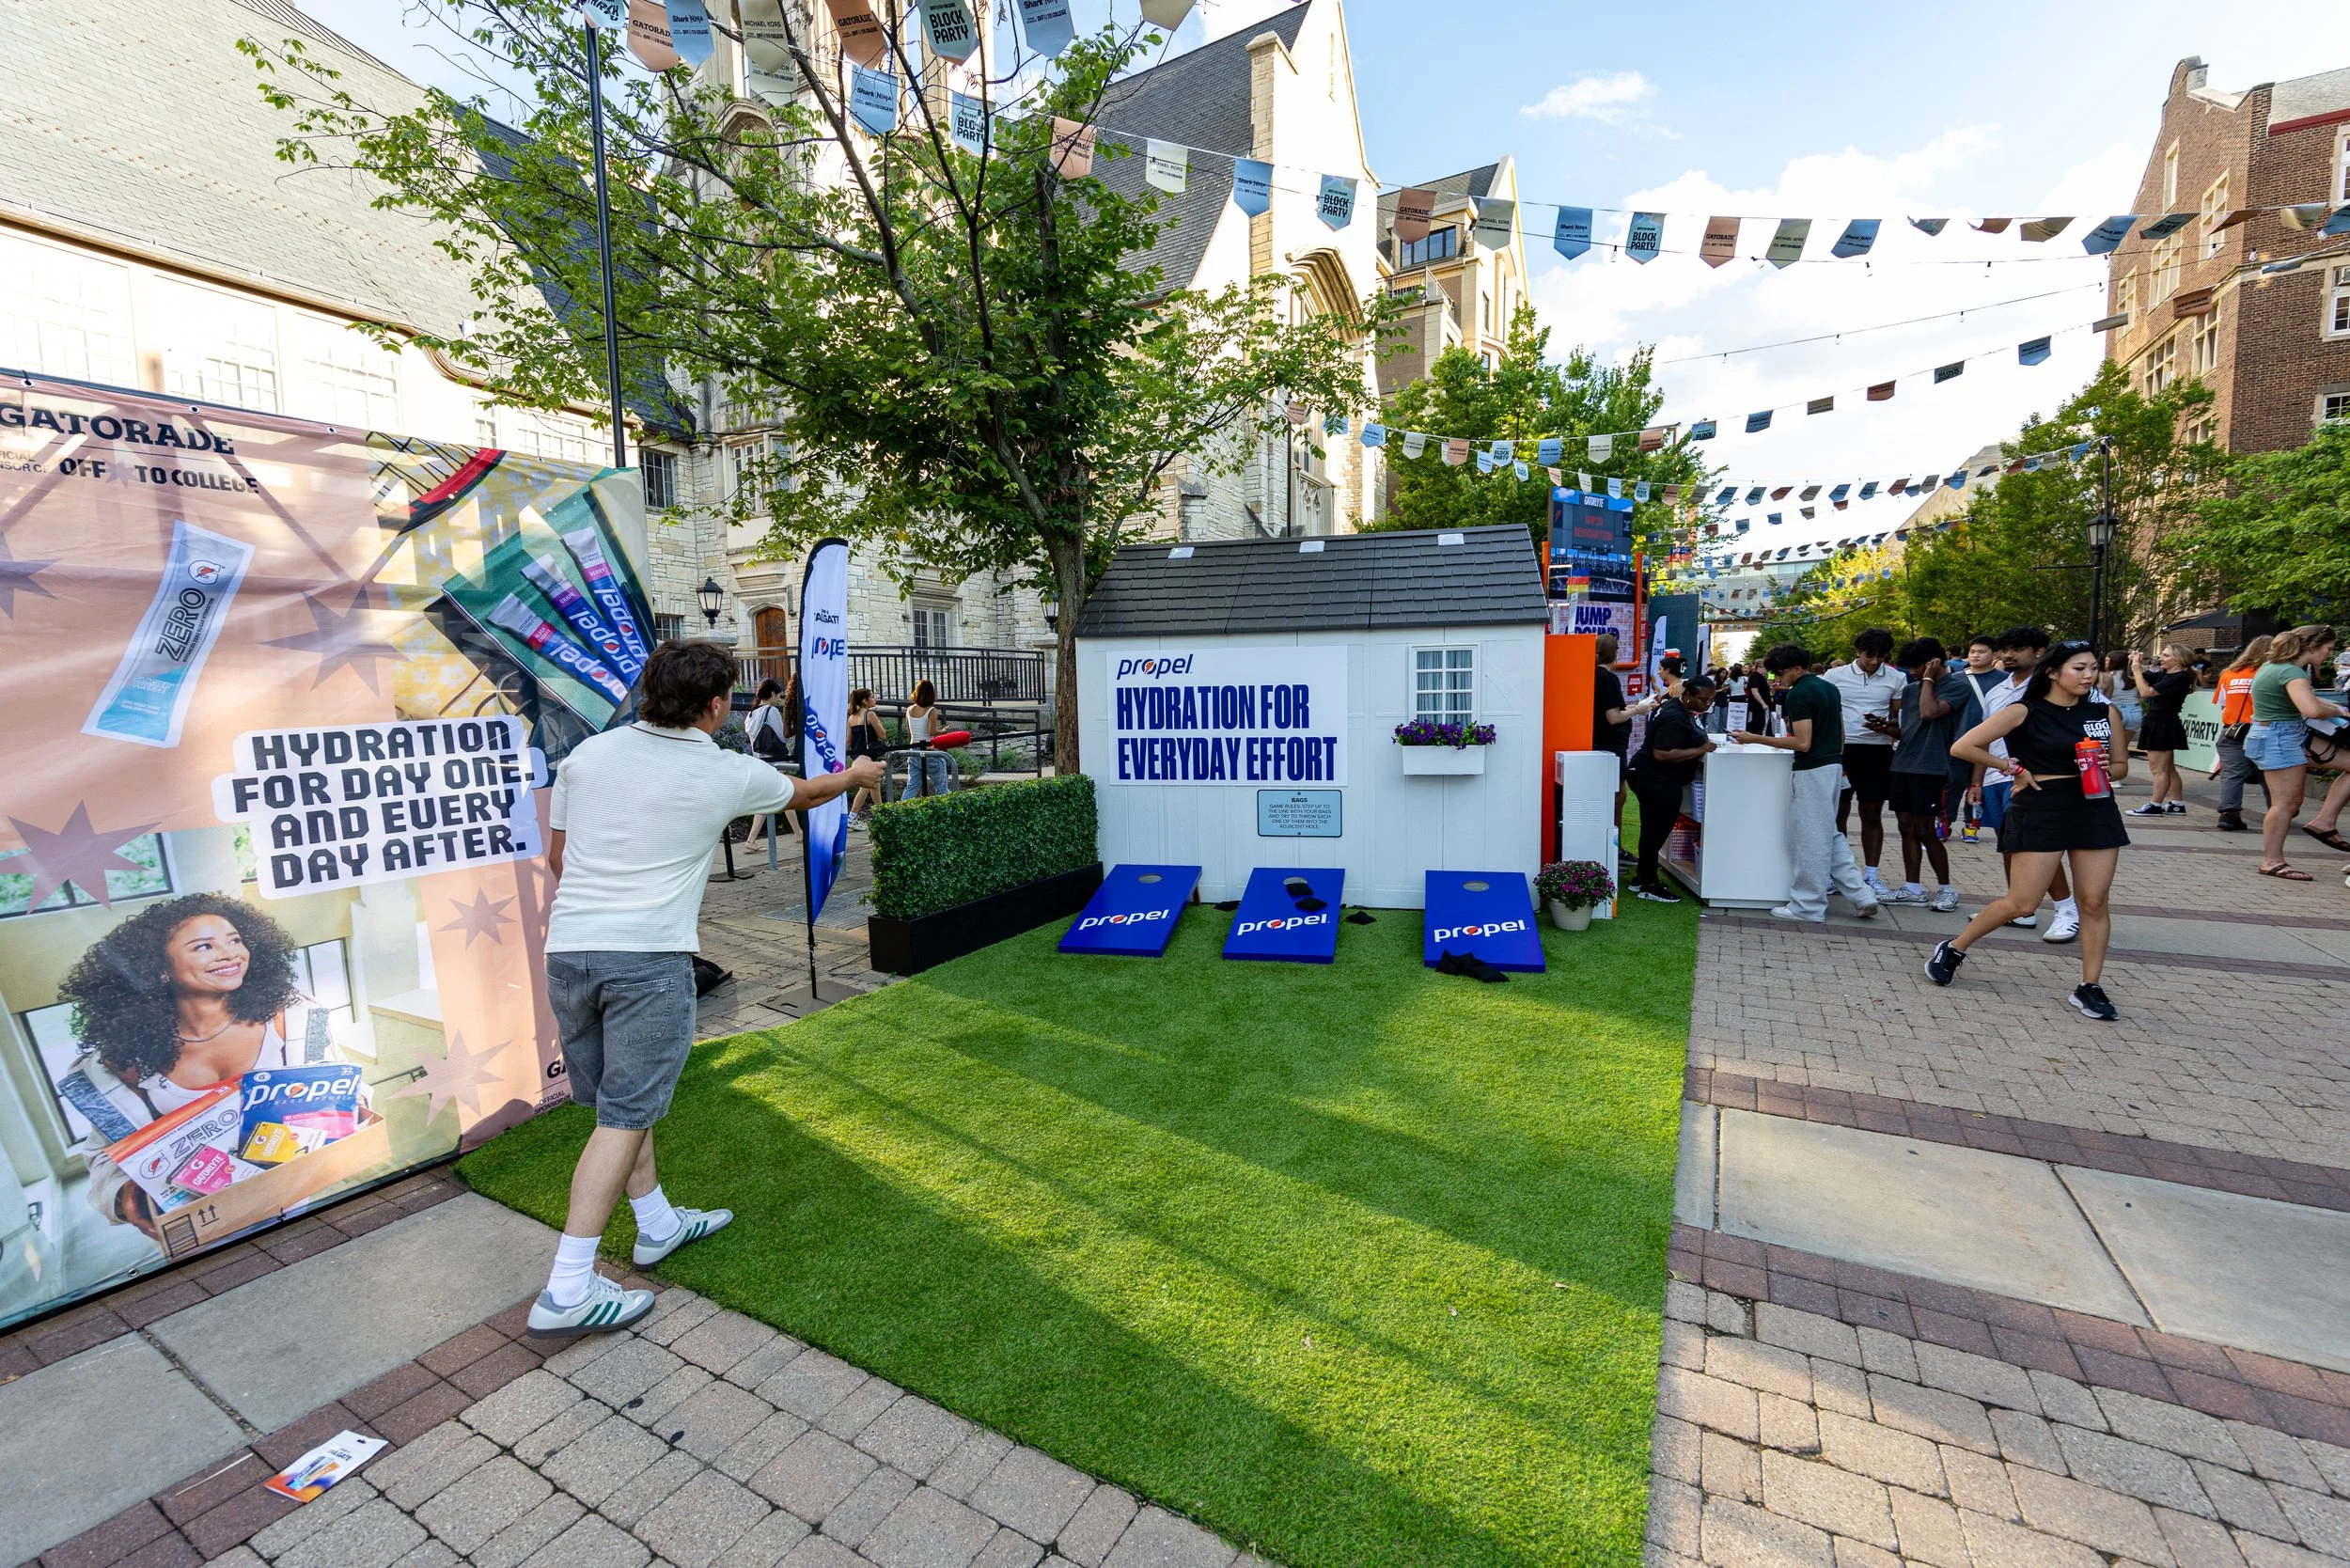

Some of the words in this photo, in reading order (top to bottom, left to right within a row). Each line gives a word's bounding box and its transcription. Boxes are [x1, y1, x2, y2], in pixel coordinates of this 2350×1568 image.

[633, 19, 672, 39] GATORAD
[838, 14, 872, 27] GATORADE
[929, 9, 966, 29] BLOCK
[932, 24, 969, 44] PARTY
[856, 86, 875, 98] Shark
[1323, 204, 1348, 218] PARTY
[1324, 194, 1349, 209] BLOCK
[1400, 206, 1432, 215] GATORADE
[1630, 242, 1655, 251] PARTY
[1633, 232, 1656, 242] BLOCK
[0, 403, 235, 456] GATORADE
[60, 457, 107, 478] OFF
[133, 465, 167, 484] TO
[171, 469, 259, 494] COLLEGE
[559, 591, 575, 604] GRAPE
[154, 588, 206, 662] ZERO
[594, 586, 650, 660] propel
[569, 608, 643, 674] propel
[549, 641, 629, 702] propel
[1117, 653, 1194, 681] propel
[1117, 684, 1256, 730] HYDRATION
[1261, 684, 1310, 729] FOR
[2191, 720, 2219, 742] PARTY
[252, 721, 510, 771] HYDRATION
[1118, 737, 1241, 781] EVERYDAY
[1246, 737, 1338, 781] EFFORT
[232, 772, 331, 813] FOR
[341, 761, 431, 801] DAY
[444, 754, 535, 791] ONE.
[271, 806, 369, 850] AND
[381, 789, 516, 834] EVERY
[271, 842, 368, 889] DAY
[382, 824, 526, 872] AFTER.
[1078, 909, 1169, 931] propel
[1237, 914, 1327, 936] propel
[1434, 919, 1526, 943] propel
[243, 1074, 360, 1112] propel
[540, 1090, 566, 1105] OFFICIAL
[170, 1109, 239, 1160] ZERO
[192, 1153, 225, 1186] GATORLYTE
